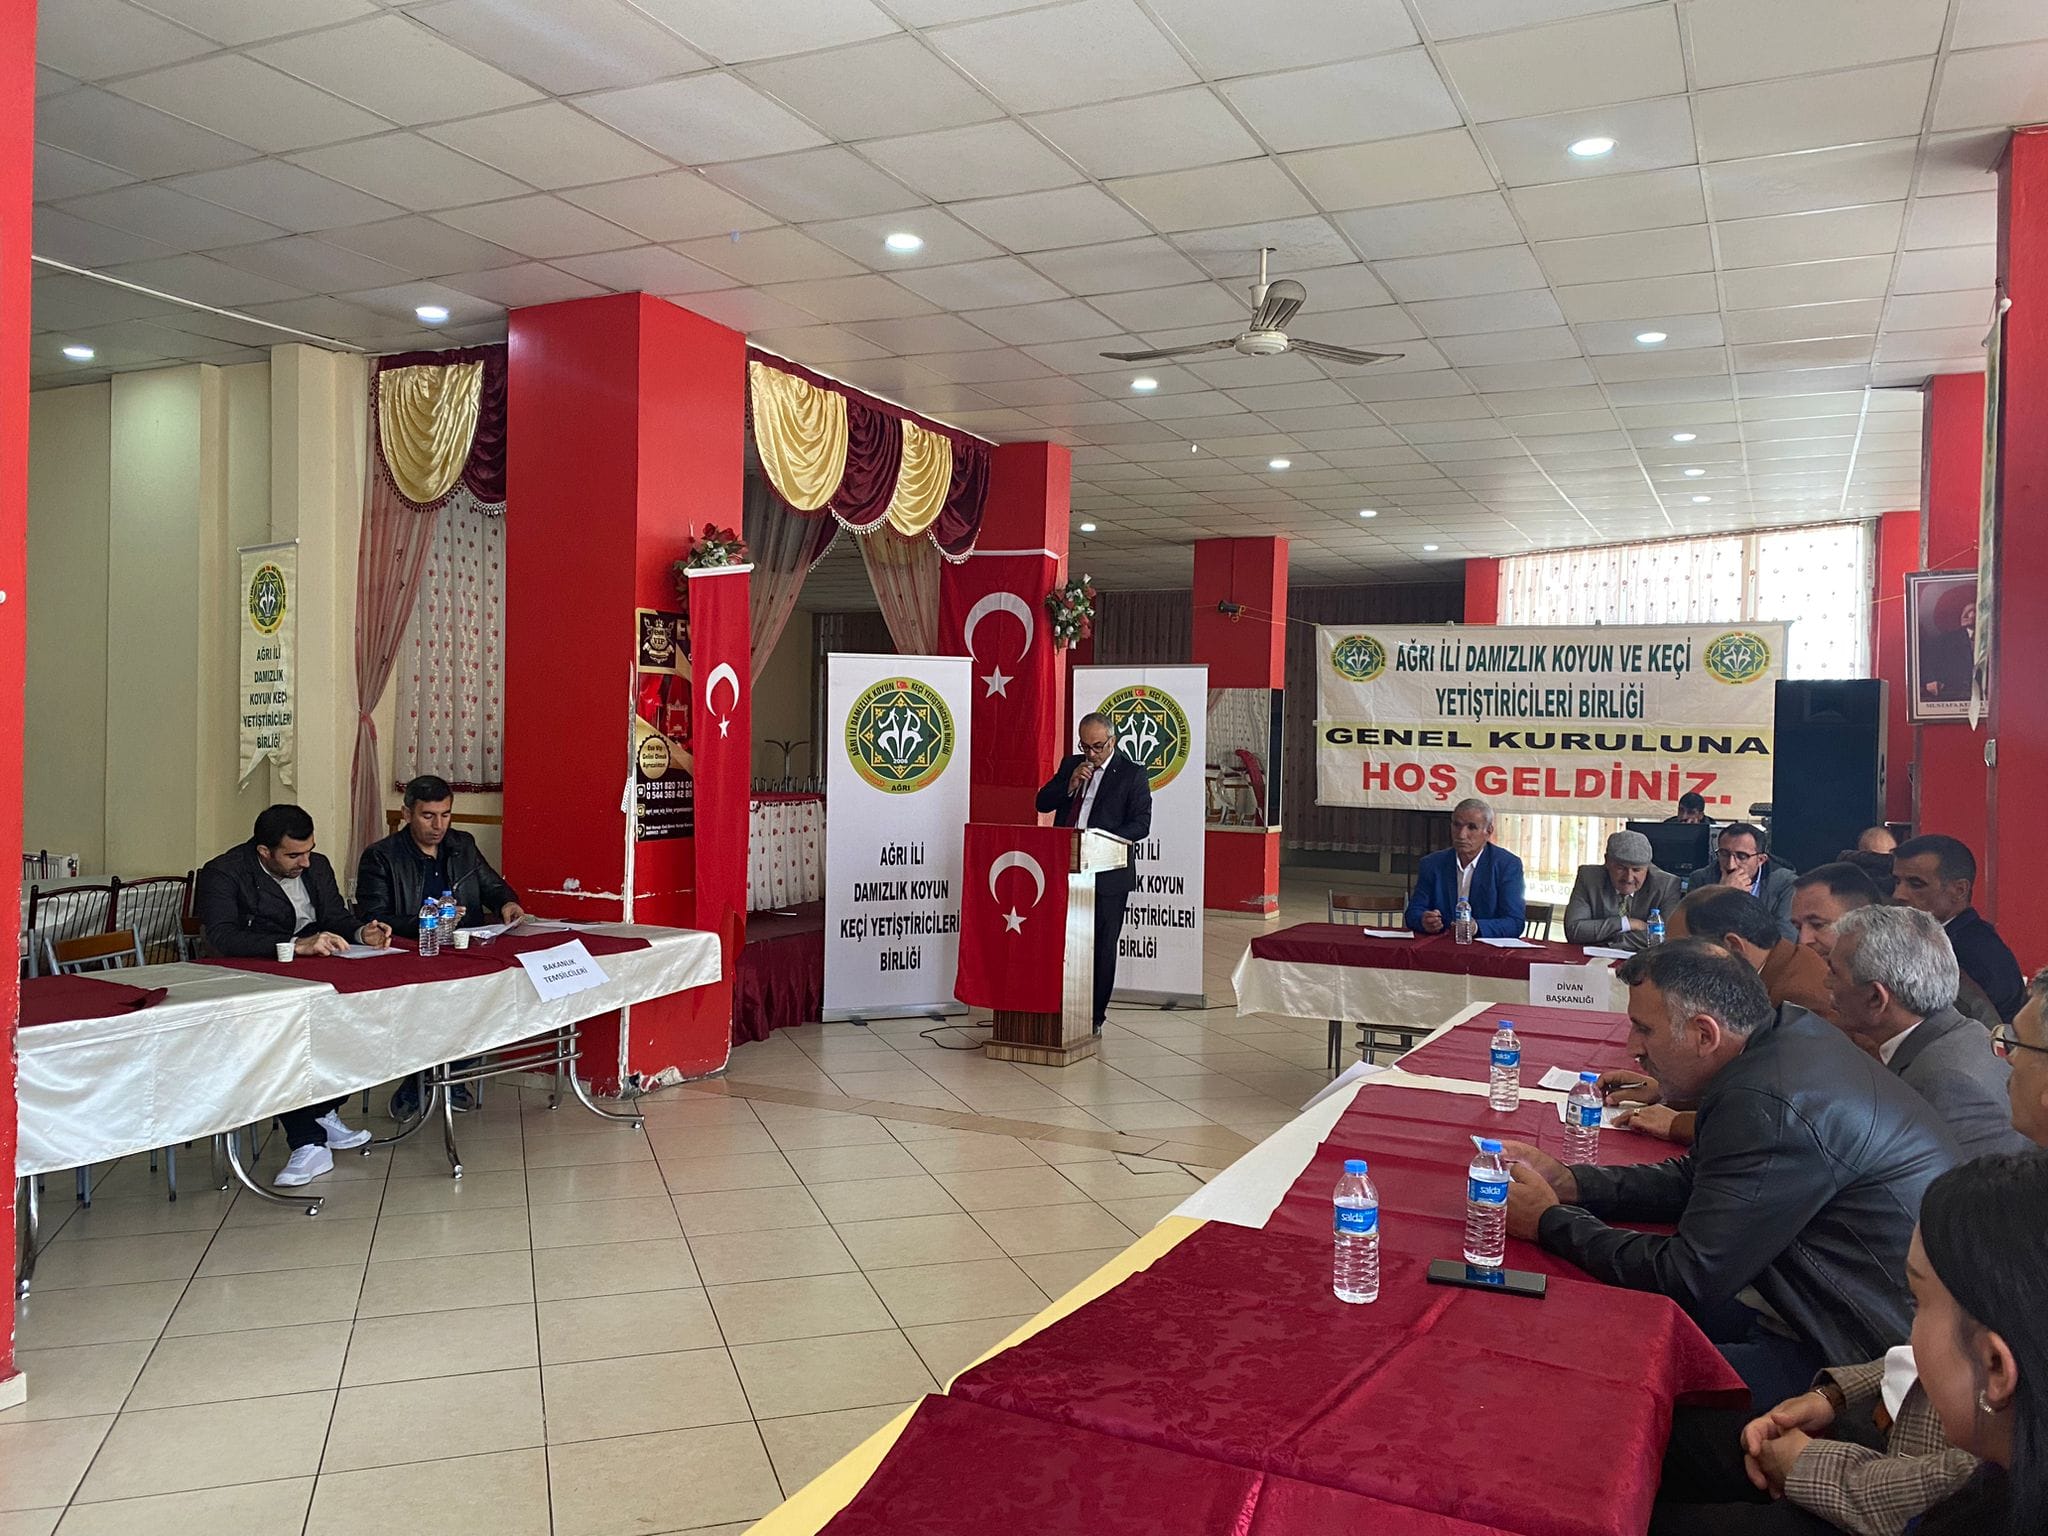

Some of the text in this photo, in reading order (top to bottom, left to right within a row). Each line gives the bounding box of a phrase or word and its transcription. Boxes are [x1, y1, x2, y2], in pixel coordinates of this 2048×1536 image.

[654, 637, 665, 645] VIP
[256, 644, 281, 661] AĞRI İLİ
[1396, 638, 1435, 672] AĞRI
[1440, 638, 1461, 672] İLİ
[1465, 645, 1547, 672] DAMIZLIK
[1552, 645, 1614, 672] KOYUN
[1619, 645, 1643, 672] VE
[1648, 637, 1691, 680] KEÇİ
[254, 669, 284, 683] DAMIZLIK
[249, 689, 288, 707] KOYUN KEÇİ
[872, 682, 895, 698] KOYUN
[1113, 690, 1134, 703] KOYUN
[1435, 681, 1644, 723] YETİŞTİRİCİLERİ BİRLİĞİ
[243, 710, 293, 730] YETİŞTİRİCİLERİ
[257, 732, 281, 749] BİRLİĞİ
[1325, 728, 1770, 755] GENEL KURULUNA
[646, 782, 651, 790] 0
[652, 782, 663, 790] 531
[1363, 762, 1732, 805] HOŞ GELDİNİZ.
[646, 791, 651, 799] 0
[880, 841, 924, 866] AĞRI İLİ
[1148, 838, 1160, 861] İLİ
[854, 880, 949, 902] DAMIZLIK KOYUN
[1147, 875, 1184, 895] KOYUN
[1124, 902, 1195, 930] TİŞTİRİCİLERİ
[840, 909, 960, 943] KEÇİ YETİŞTİRİCİLERİ
[1119, 935, 1157, 959] BİRLİĞİ
[542, 959, 576, 972] BAKANLIK
[880, 945, 921, 971] BİRLİĞİ
[543, 966, 589, 984] TEMSİLCİLERİ
[1557, 982, 1584, 991] DİVAN
[1546, 994, 1594, 1004] BAŞKANLIĞI
[1480, 1185, 1501, 1195] salda
[1341, 1212, 1364, 1223] salda
